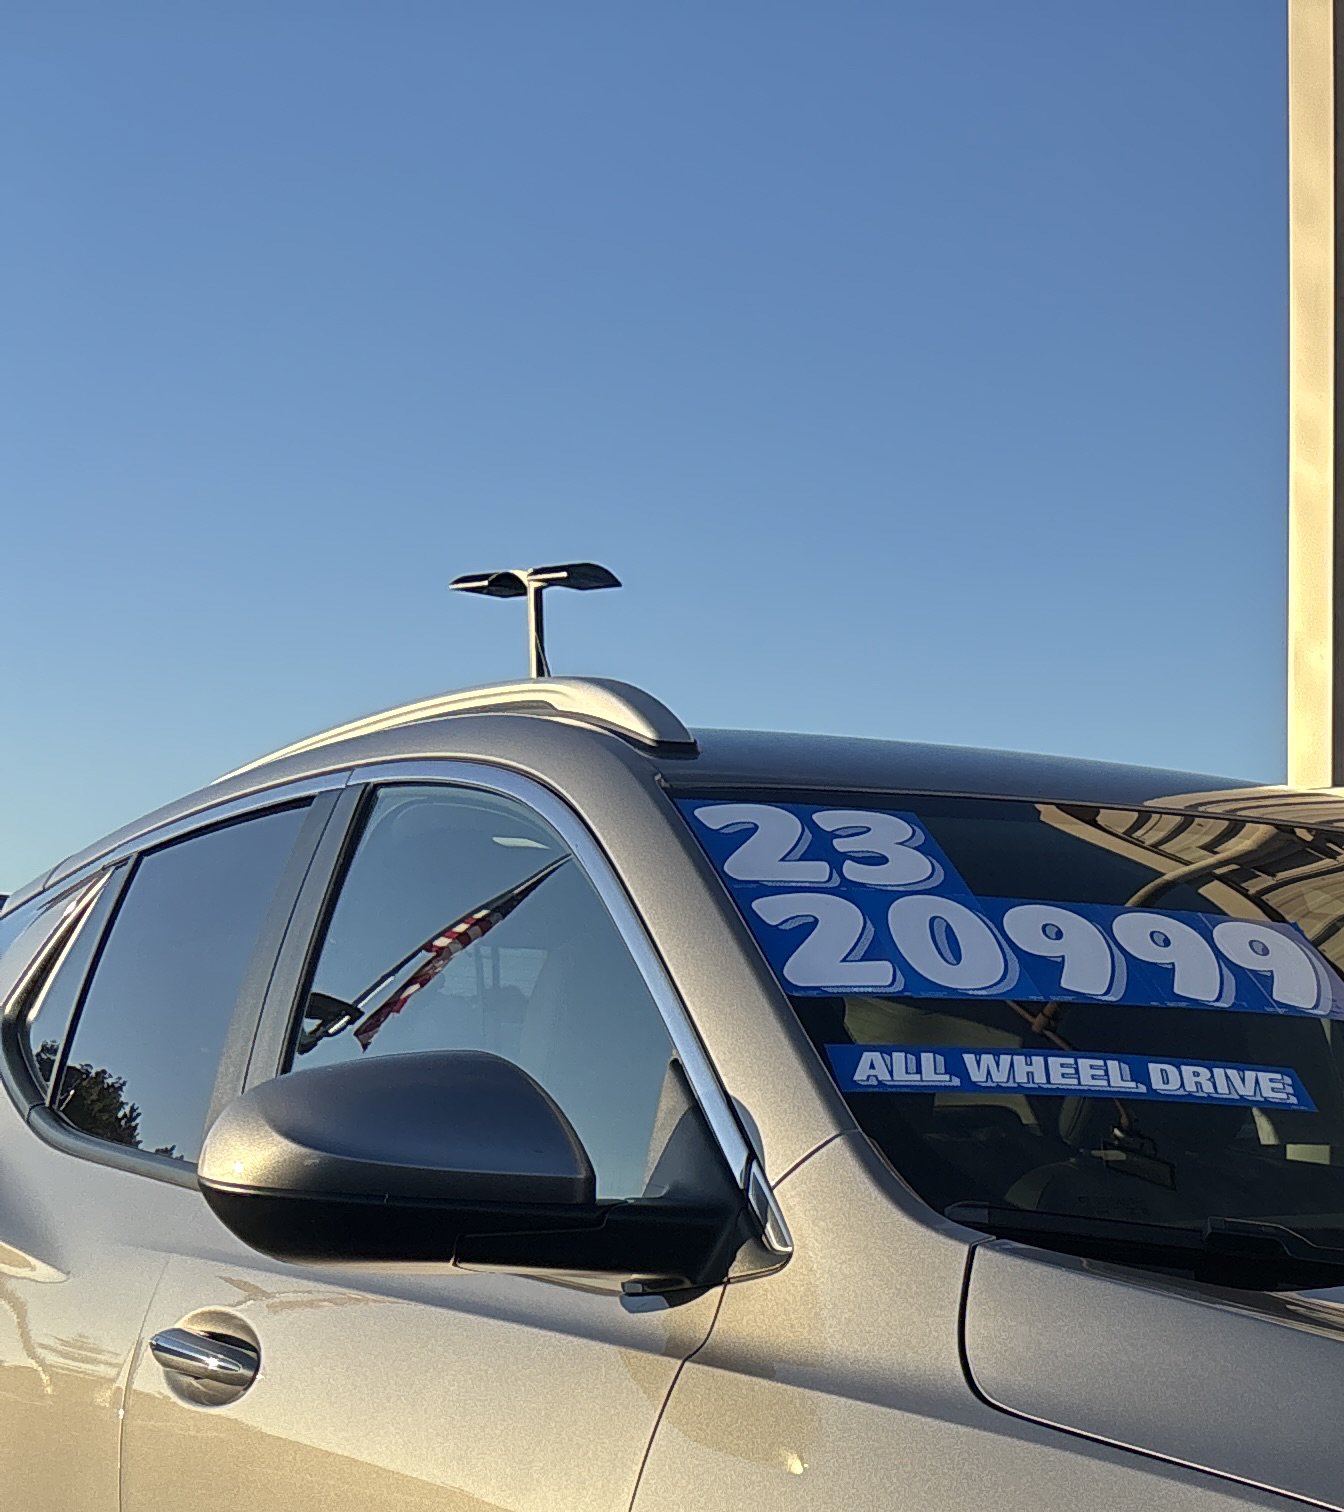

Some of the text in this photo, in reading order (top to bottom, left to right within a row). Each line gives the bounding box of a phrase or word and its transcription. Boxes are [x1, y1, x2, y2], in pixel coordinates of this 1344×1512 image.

[695, 804, 936, 888] 23
[752, 894, 1324, 1012] 20999
[854, 1051, 1298, 1103] ALL WHEEL DRIVE
